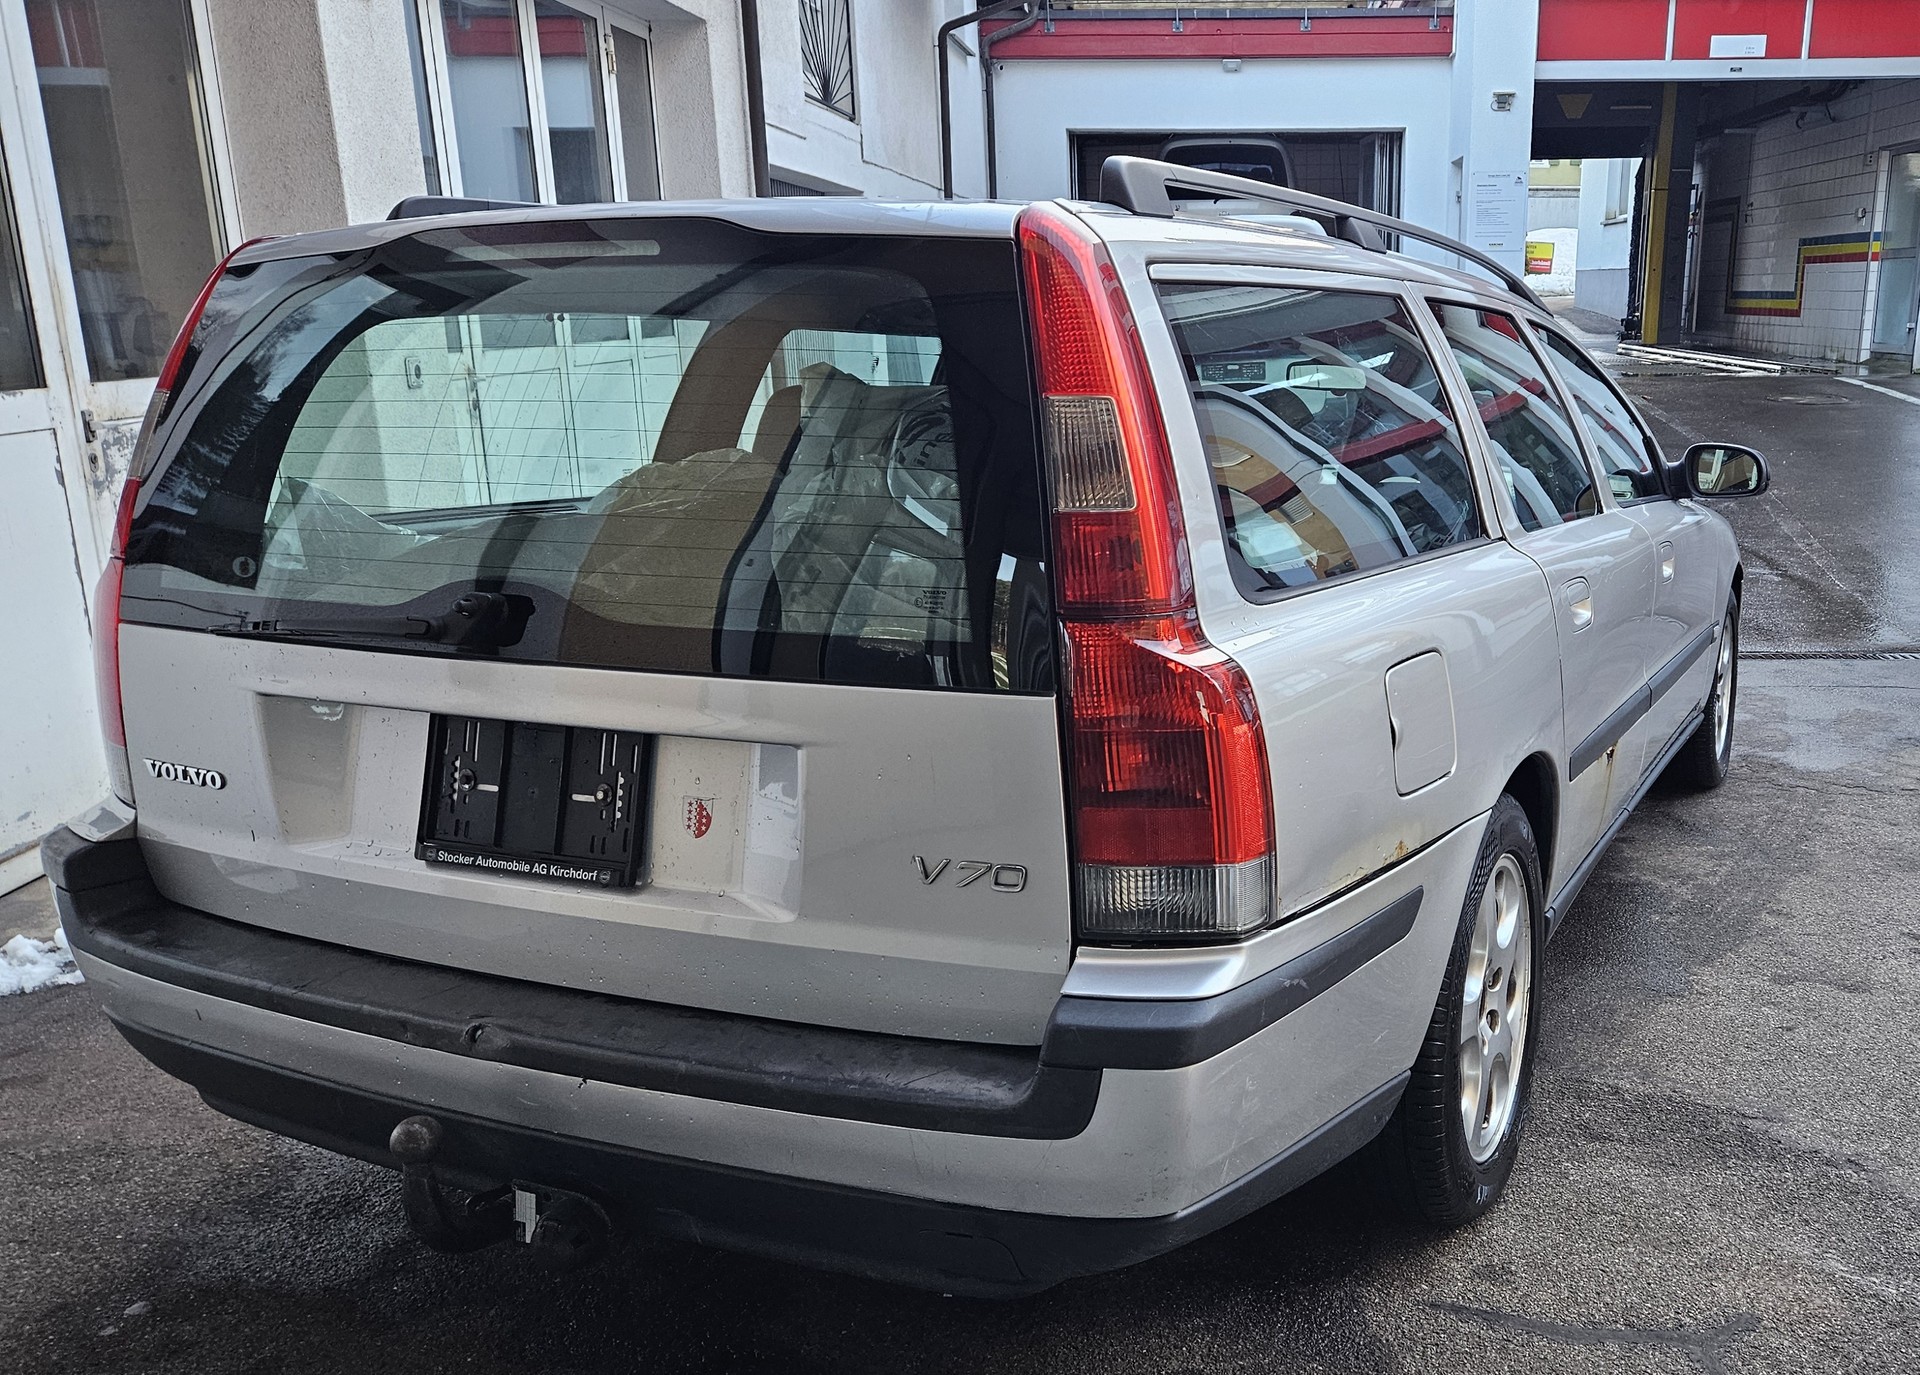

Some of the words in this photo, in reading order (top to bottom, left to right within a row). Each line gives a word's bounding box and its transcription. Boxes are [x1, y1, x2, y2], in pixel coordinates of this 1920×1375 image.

[142, 758, 226, 790] VOLVO
[437, 850, 474, 865] Stocker
[475, 855, 531, 873] Automobile
[532, 863, 548, 875] AG
[549, 865, 598, 881] Kirchdorf
